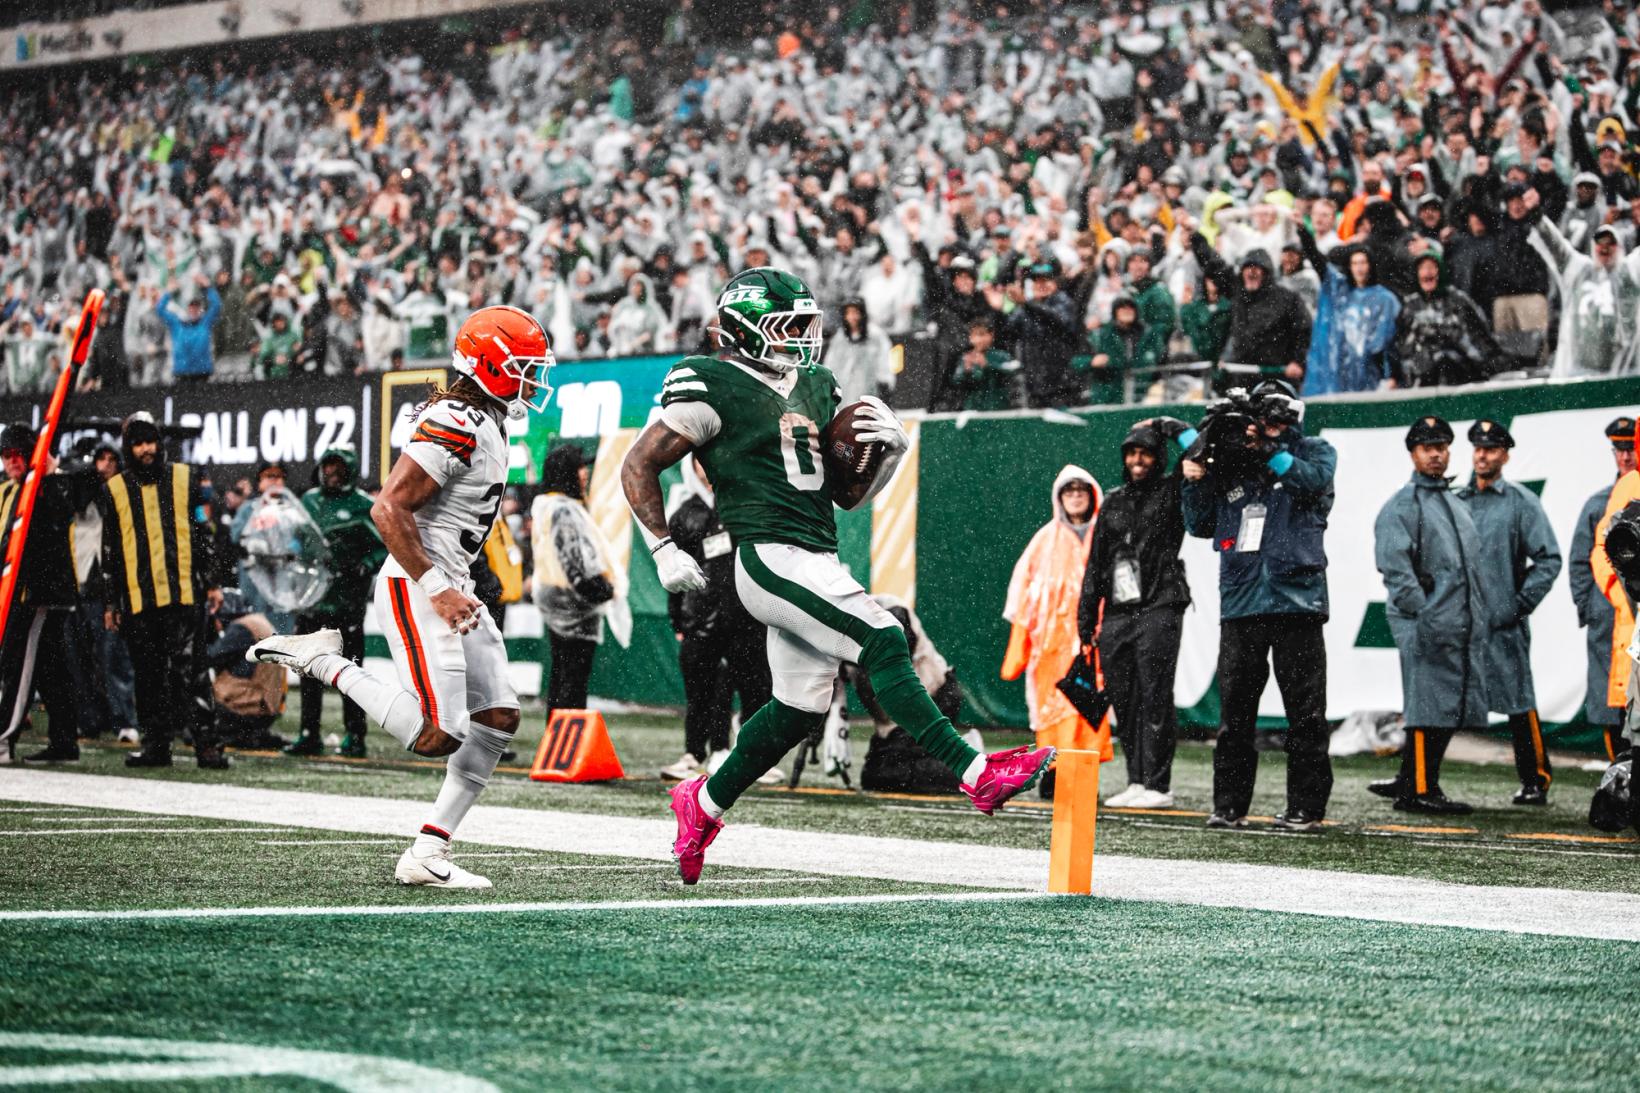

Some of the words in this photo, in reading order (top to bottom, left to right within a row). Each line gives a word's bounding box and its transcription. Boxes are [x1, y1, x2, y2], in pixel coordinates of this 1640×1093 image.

[717, 284, 768, 309] JETS
[260, 408, 308, 463] ON
[314, 405, 357, 461] 22
[779, 412, 825, 491] 0
[541, 718, 586, 770] 10
